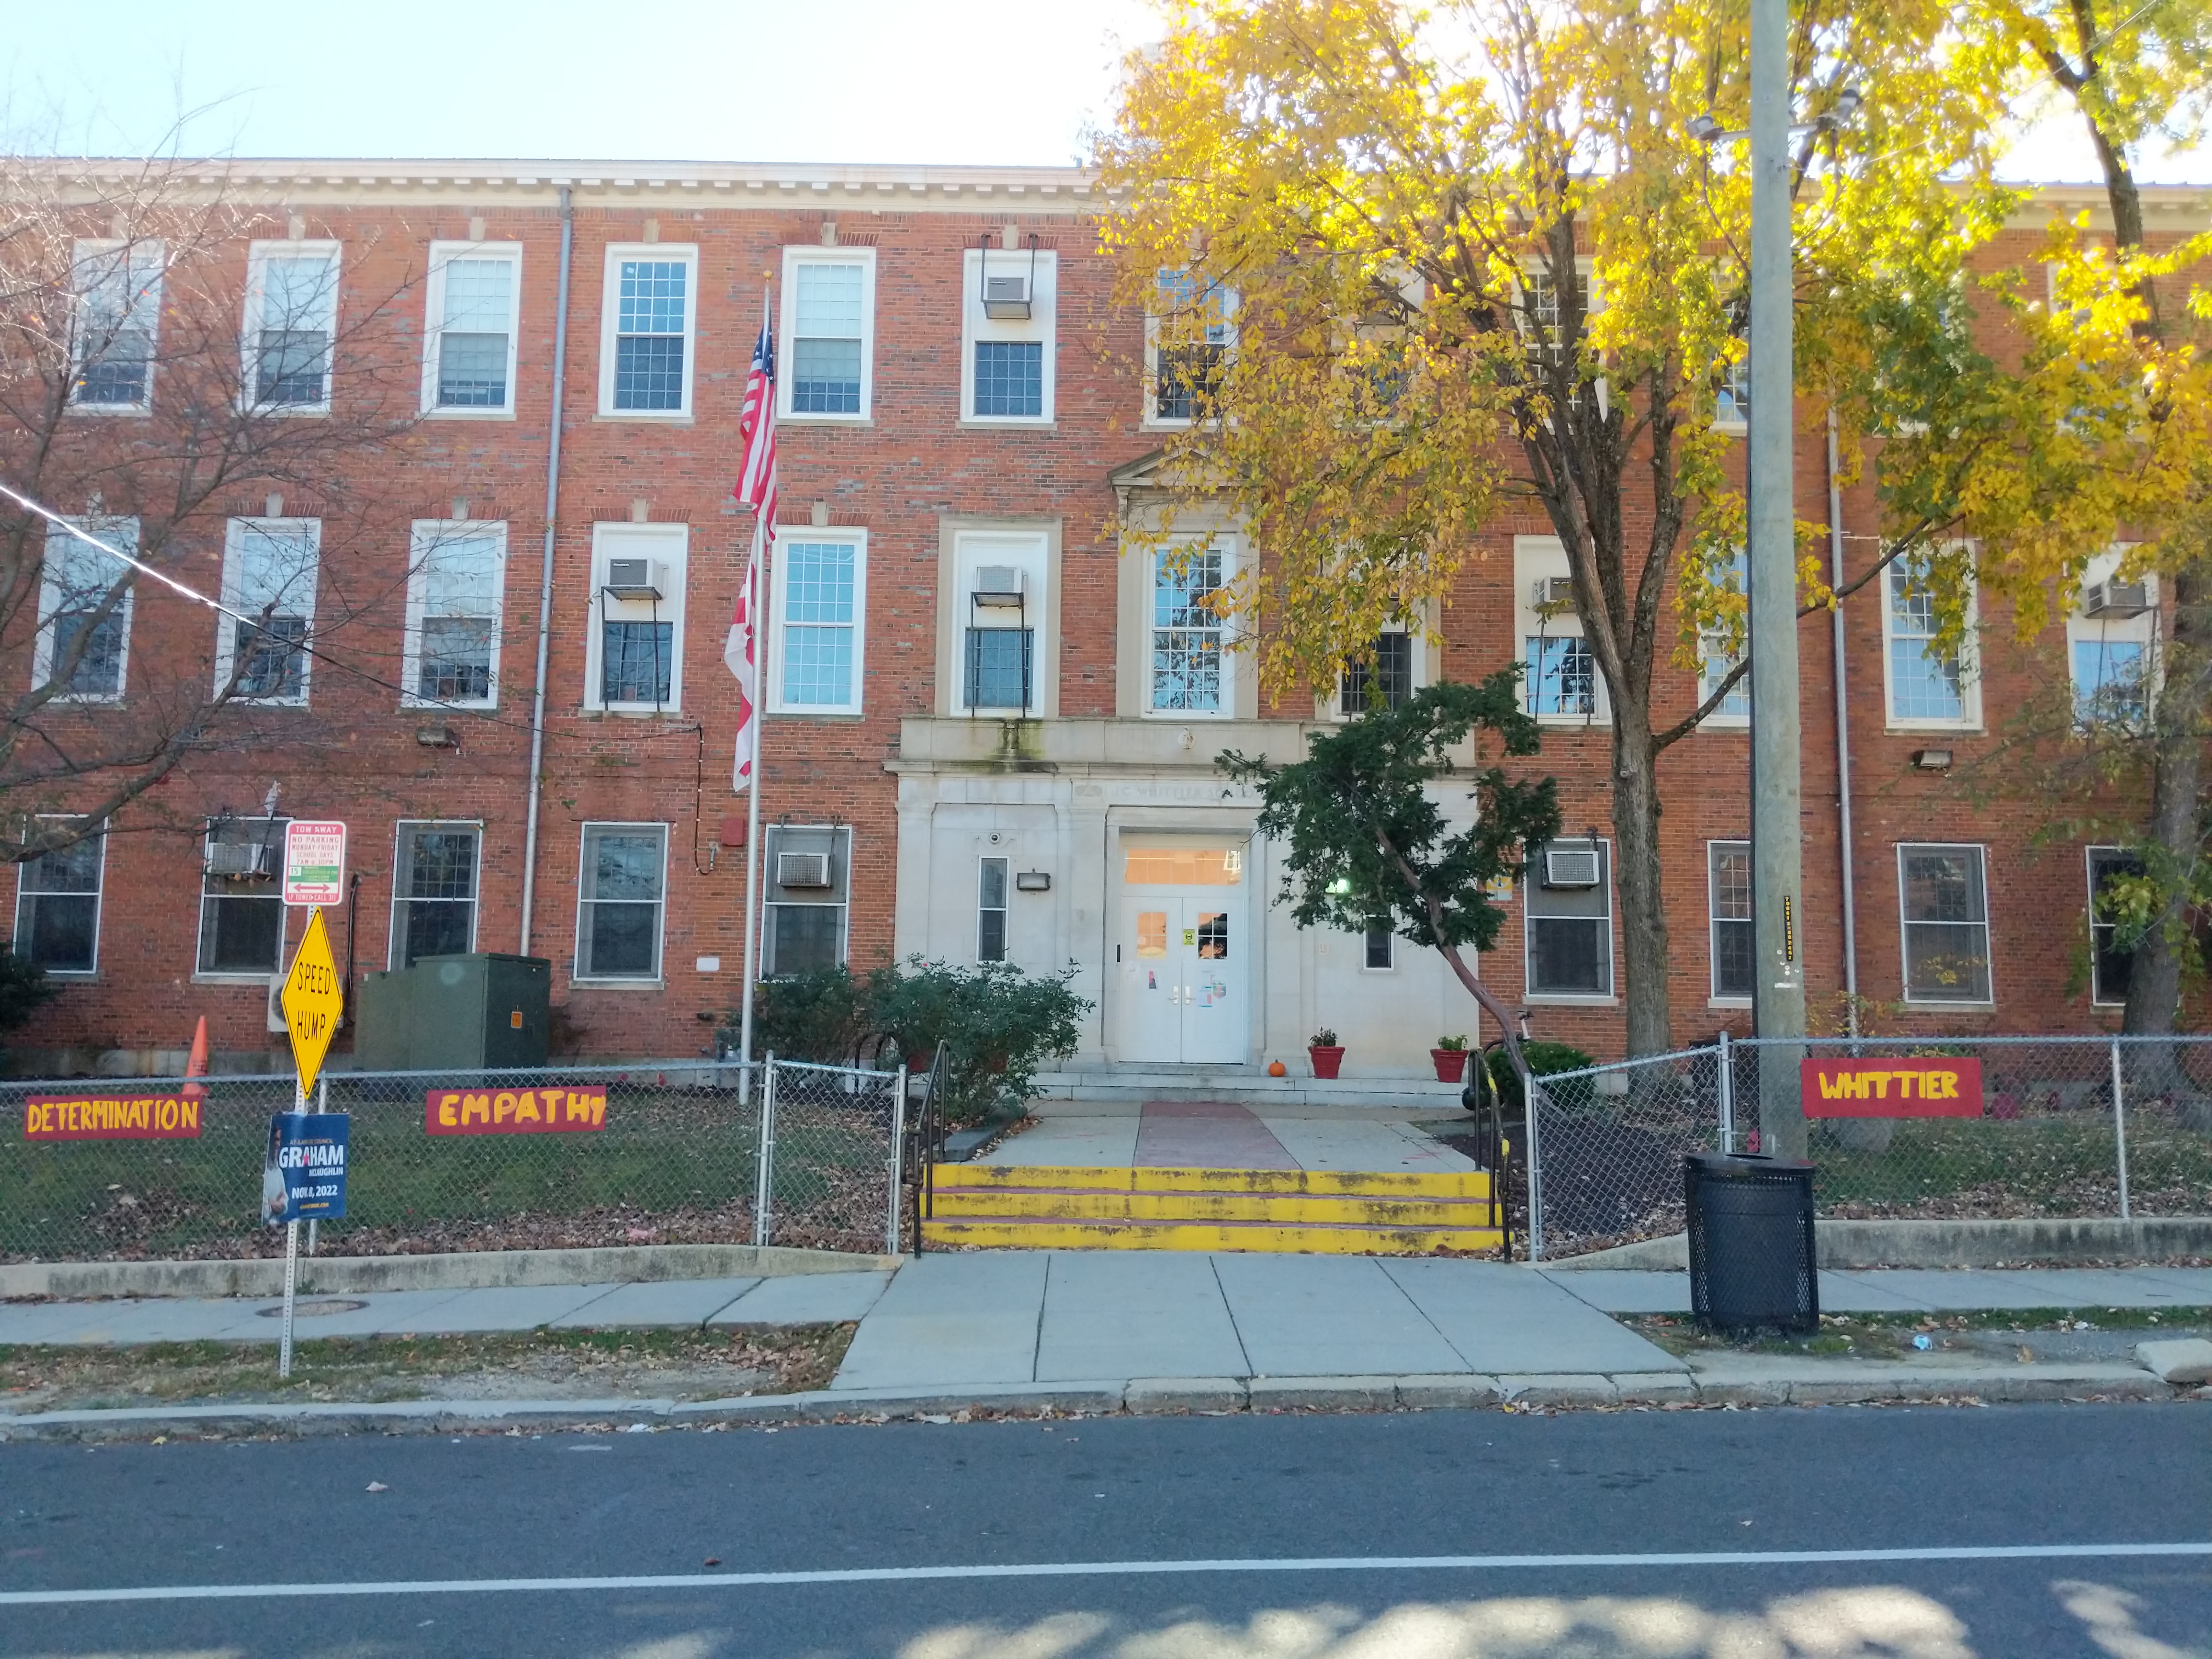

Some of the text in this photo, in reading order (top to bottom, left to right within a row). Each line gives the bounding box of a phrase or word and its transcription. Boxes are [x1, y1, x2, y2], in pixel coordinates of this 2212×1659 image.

[297, 961, 331, 995] SPEED
[296, 1010, 325, 1041] HUMP
[1819, 1071, 1959, 1099] WHITTIER
[28, 1099, 198, 1133] DETERMINATION
[439, 1091, 606, 1126] EMPATHY
[279, 1144, 343, 1169] GRAHAM
[315, 1184, 338, 1197] 2022
